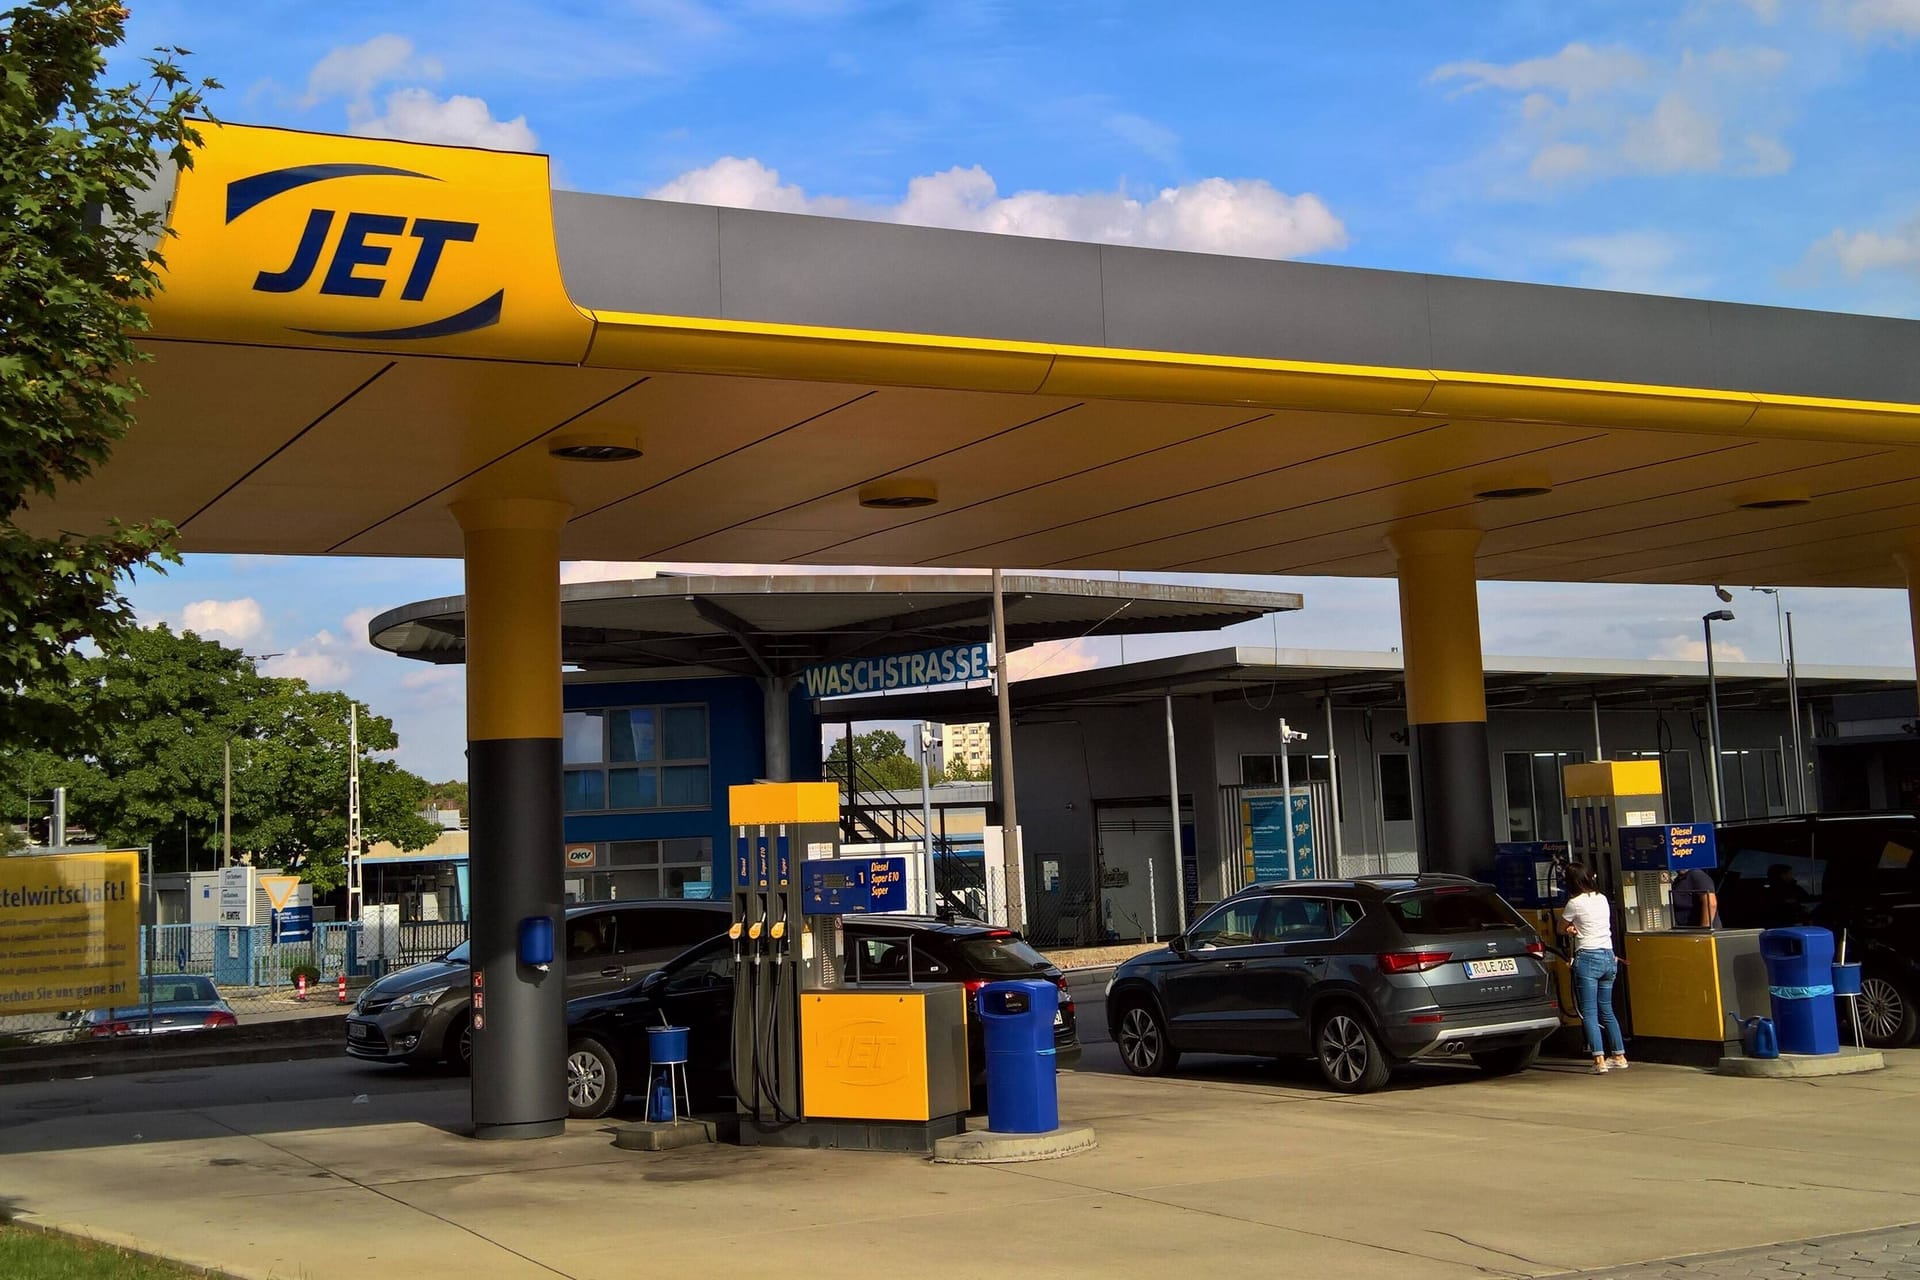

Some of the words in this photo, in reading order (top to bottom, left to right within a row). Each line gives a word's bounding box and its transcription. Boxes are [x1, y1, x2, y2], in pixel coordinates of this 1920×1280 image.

[252, 208, 480, 302] JET
[806, 646, 984, 697] WASCHSTRASSE
[1671, 826, 1693, 836] Diesel
[1659, 834, 1665, 845] 3
[1671, 837, 1692, 847] Super
[1692, 835, 1706, 844] E10
[570, 851, 592, 861] DKV
[1672, 848, 1694, 858] Super
[871, 861, 889, 873] Diesel
[858, 872, 864, 884] 1
[871, 873, 888, 885] Super
[888, 872, 899, 882] E10
[871, 887, 889, 899] Super
[1472, 963, 1481, 974] R
[1484, 961, 1497, 973] LE
[1499, 960, 1515, 971] 285
[36, 986, 53, 1000] Sie
[55, 987, 73, 998] uns
[76, 983, 106, 998] gerne
[824, 1035, 897, 1069] JET
